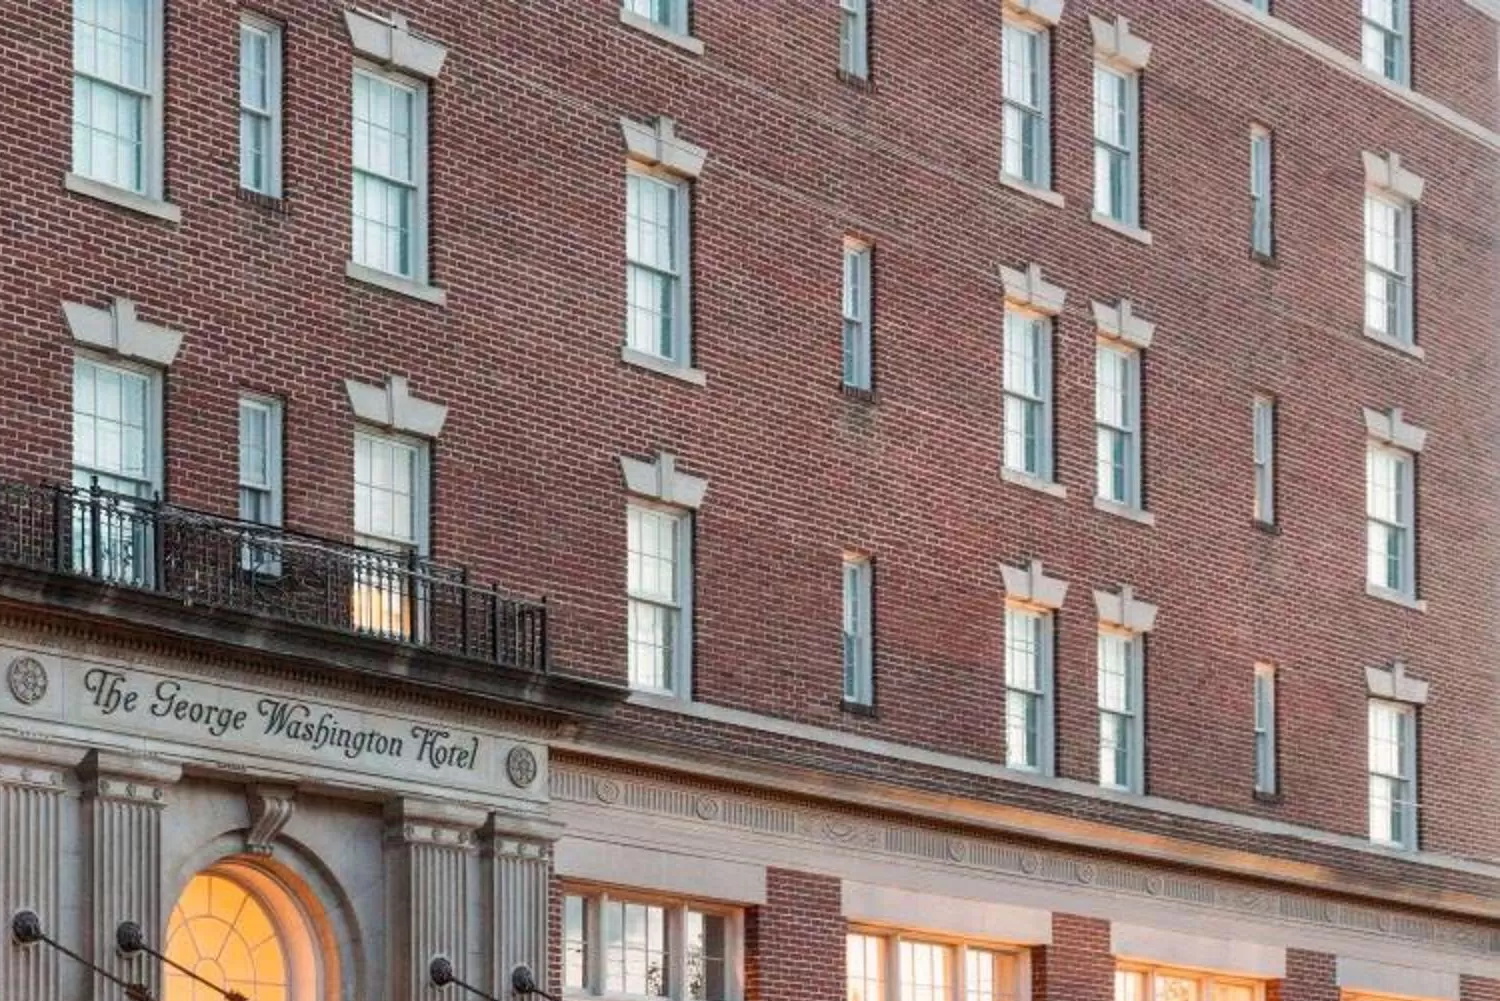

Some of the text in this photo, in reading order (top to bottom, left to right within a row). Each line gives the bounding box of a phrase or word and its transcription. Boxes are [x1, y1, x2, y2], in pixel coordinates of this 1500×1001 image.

[84, 668, 479, 769] The George Washington Hotel
